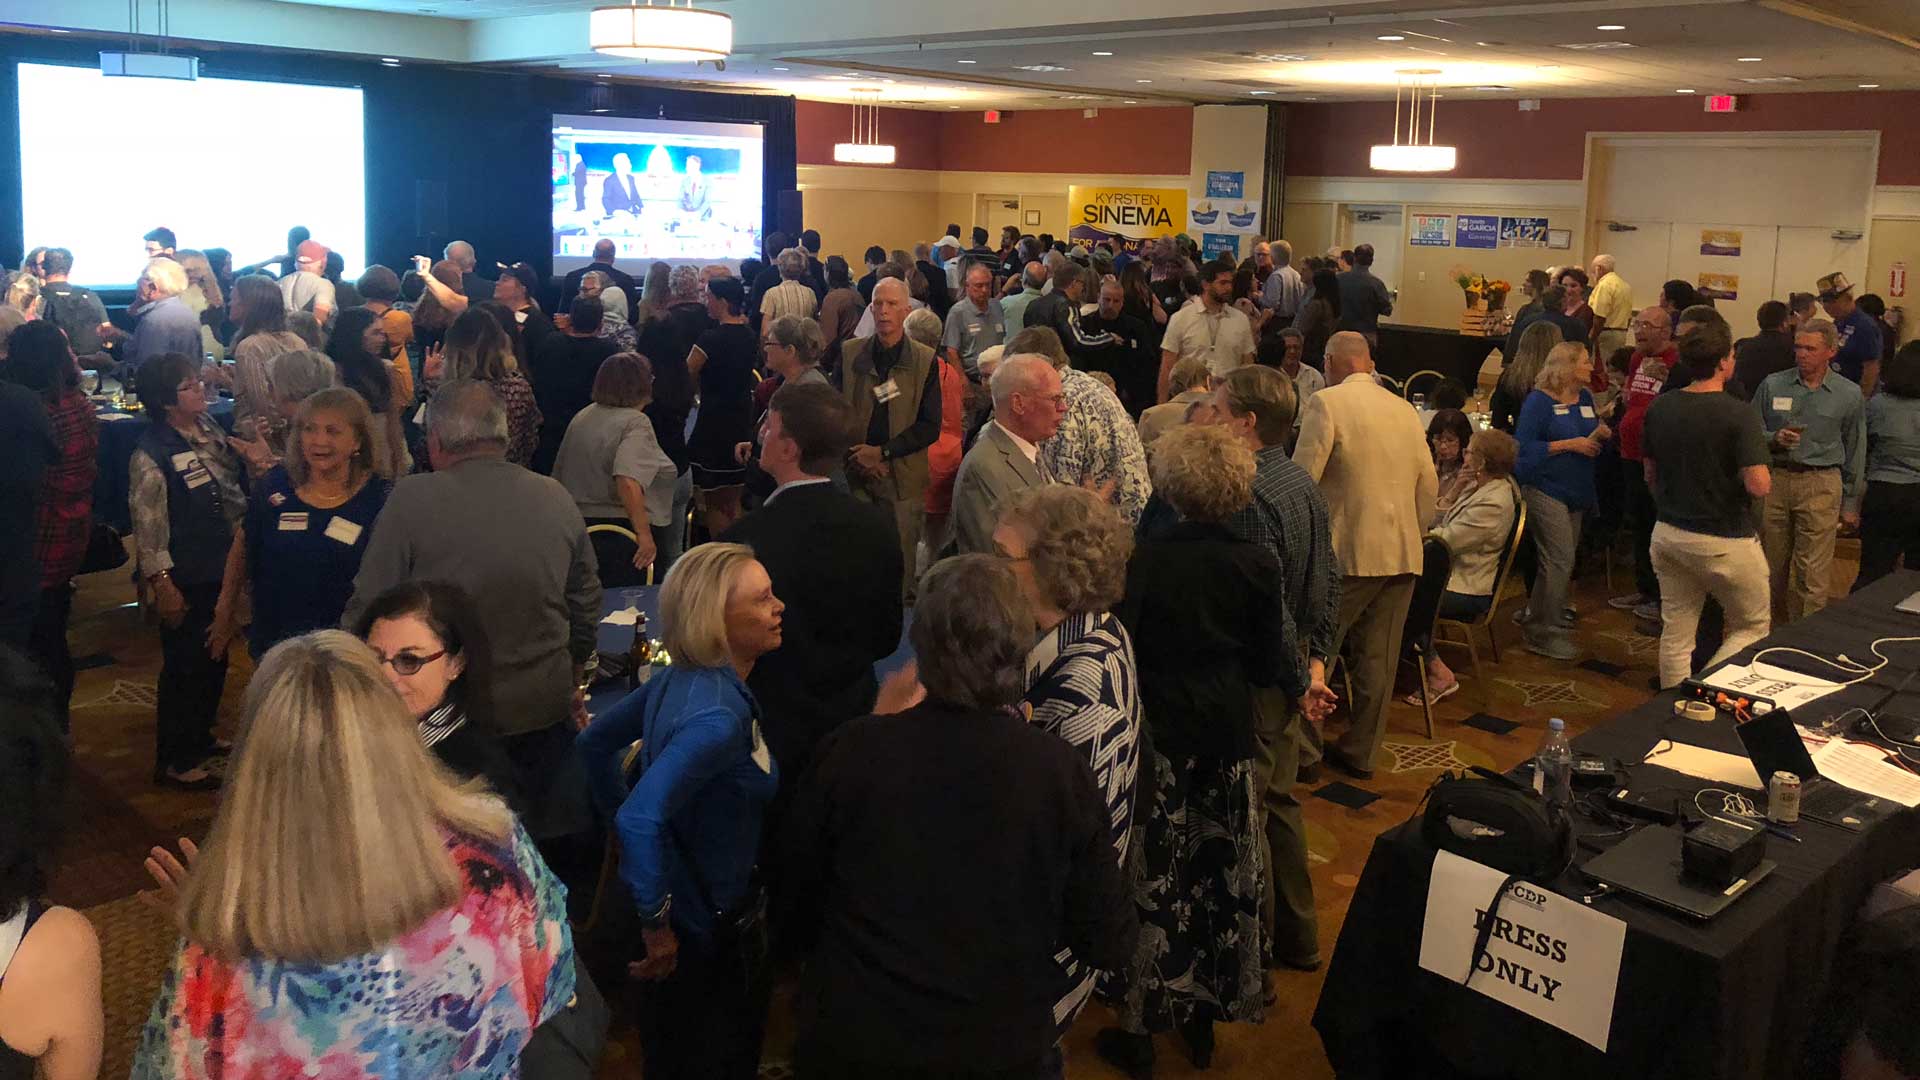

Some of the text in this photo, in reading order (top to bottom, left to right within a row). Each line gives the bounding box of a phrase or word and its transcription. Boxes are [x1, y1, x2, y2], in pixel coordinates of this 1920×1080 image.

[1095, 193, 1160, 206] KYRSTEN
[1083, 205, 1172, 227] SINEMA
[1513, 225, 1546, 241] 127
[1475, 952, 1562, 1001] ONLY
